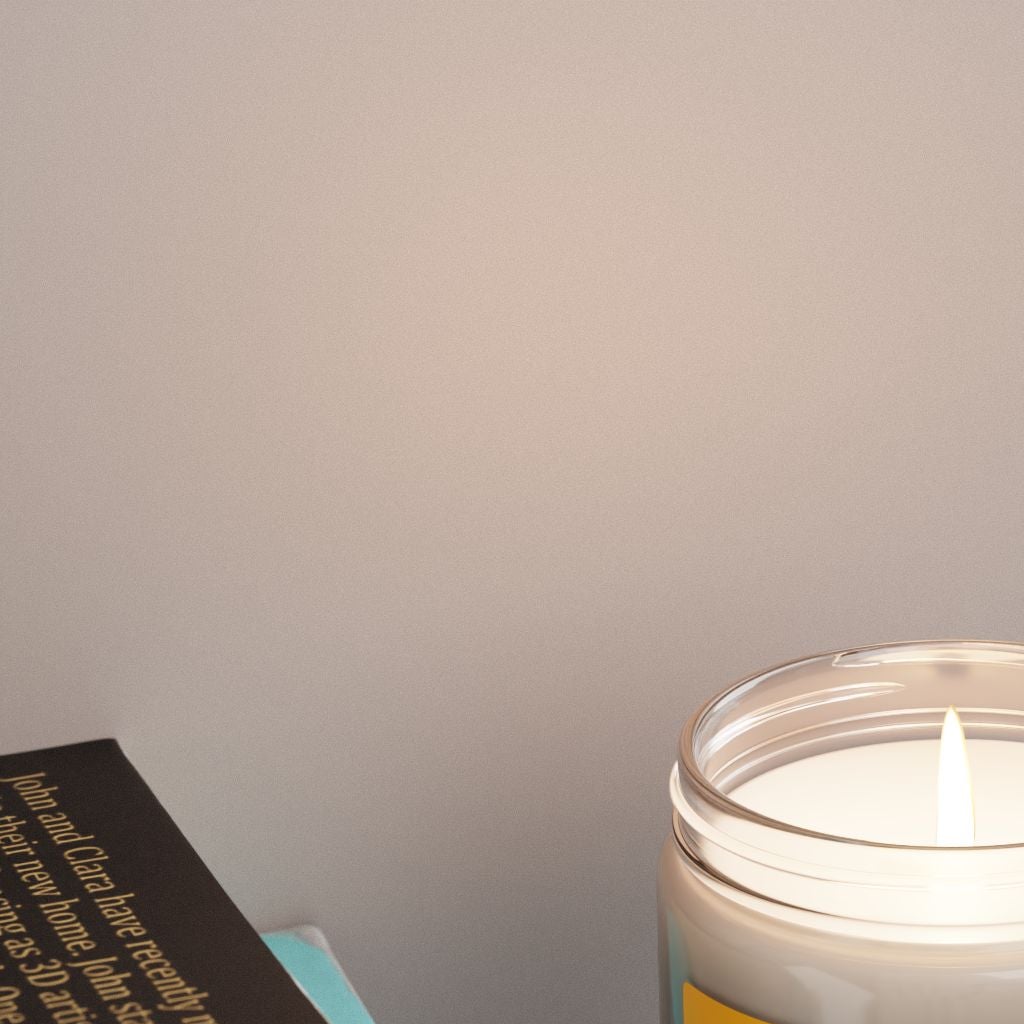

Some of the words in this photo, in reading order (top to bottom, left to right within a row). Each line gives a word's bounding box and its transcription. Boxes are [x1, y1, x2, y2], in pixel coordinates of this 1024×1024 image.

[0, 771, 58, 811] John
[0, 815, 38, 856] their
[38, 811, 95, 845] and
[13, 859, 62, 896] new
[63, 846, 115, 893] Clara
[40, 898, 97, 957] home.
[94, 892, 147, 938] have
[3, 937, 41, 958] as
[18, 956, 70, 987] 3D
[66, 955, 132, 1001] John
[125, 940, 209, 1012] recently
